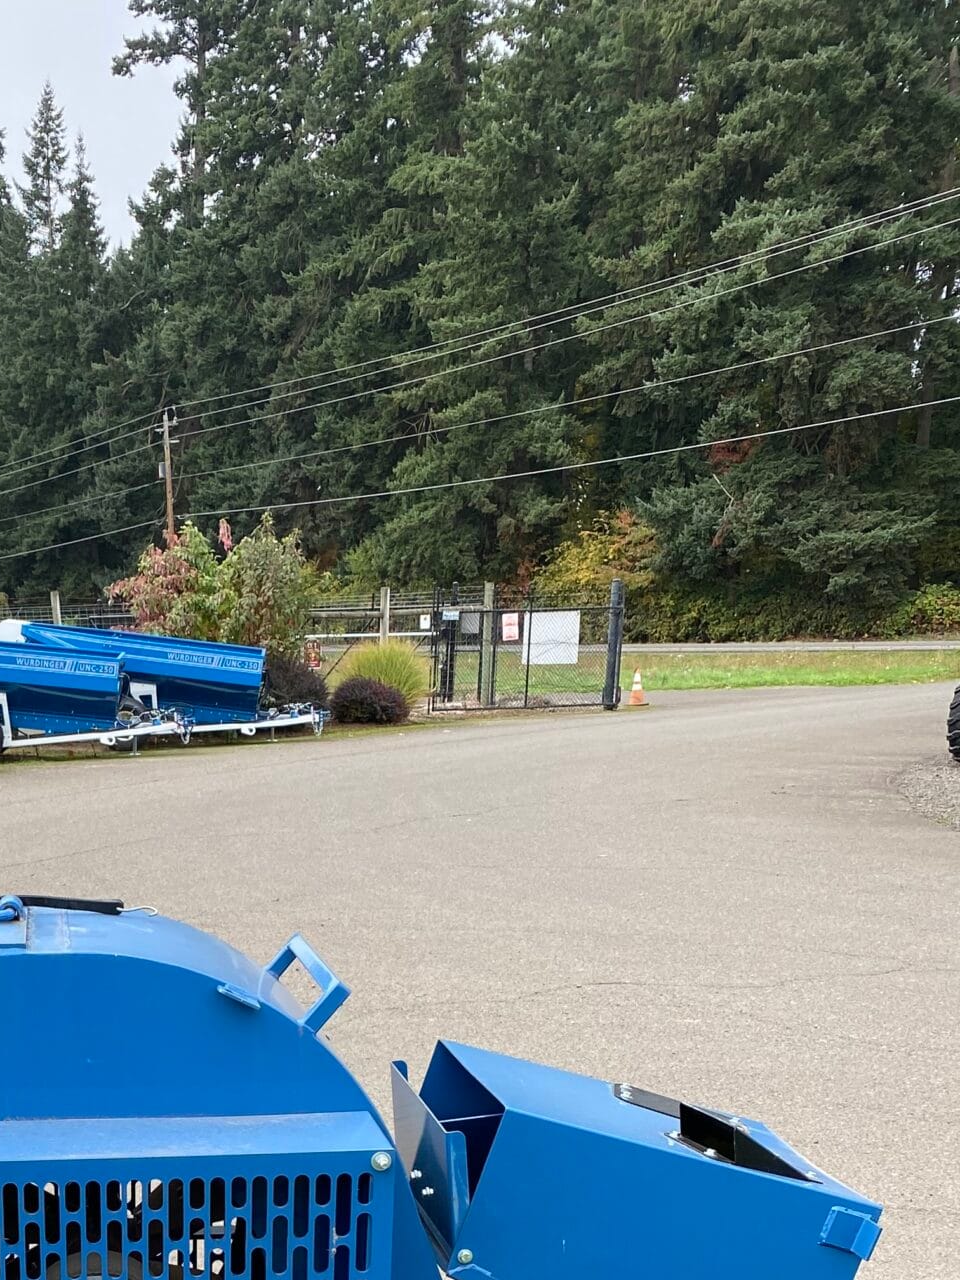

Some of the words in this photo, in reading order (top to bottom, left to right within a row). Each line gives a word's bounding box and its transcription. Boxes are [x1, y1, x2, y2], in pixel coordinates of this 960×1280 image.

[16, 656, 64, 669] WURDINGER
[80, 663, 114, 674] UNC-250
[167, 652, 212, 664] WURDINGER
[226, 659, 258, 670] UNC-250
